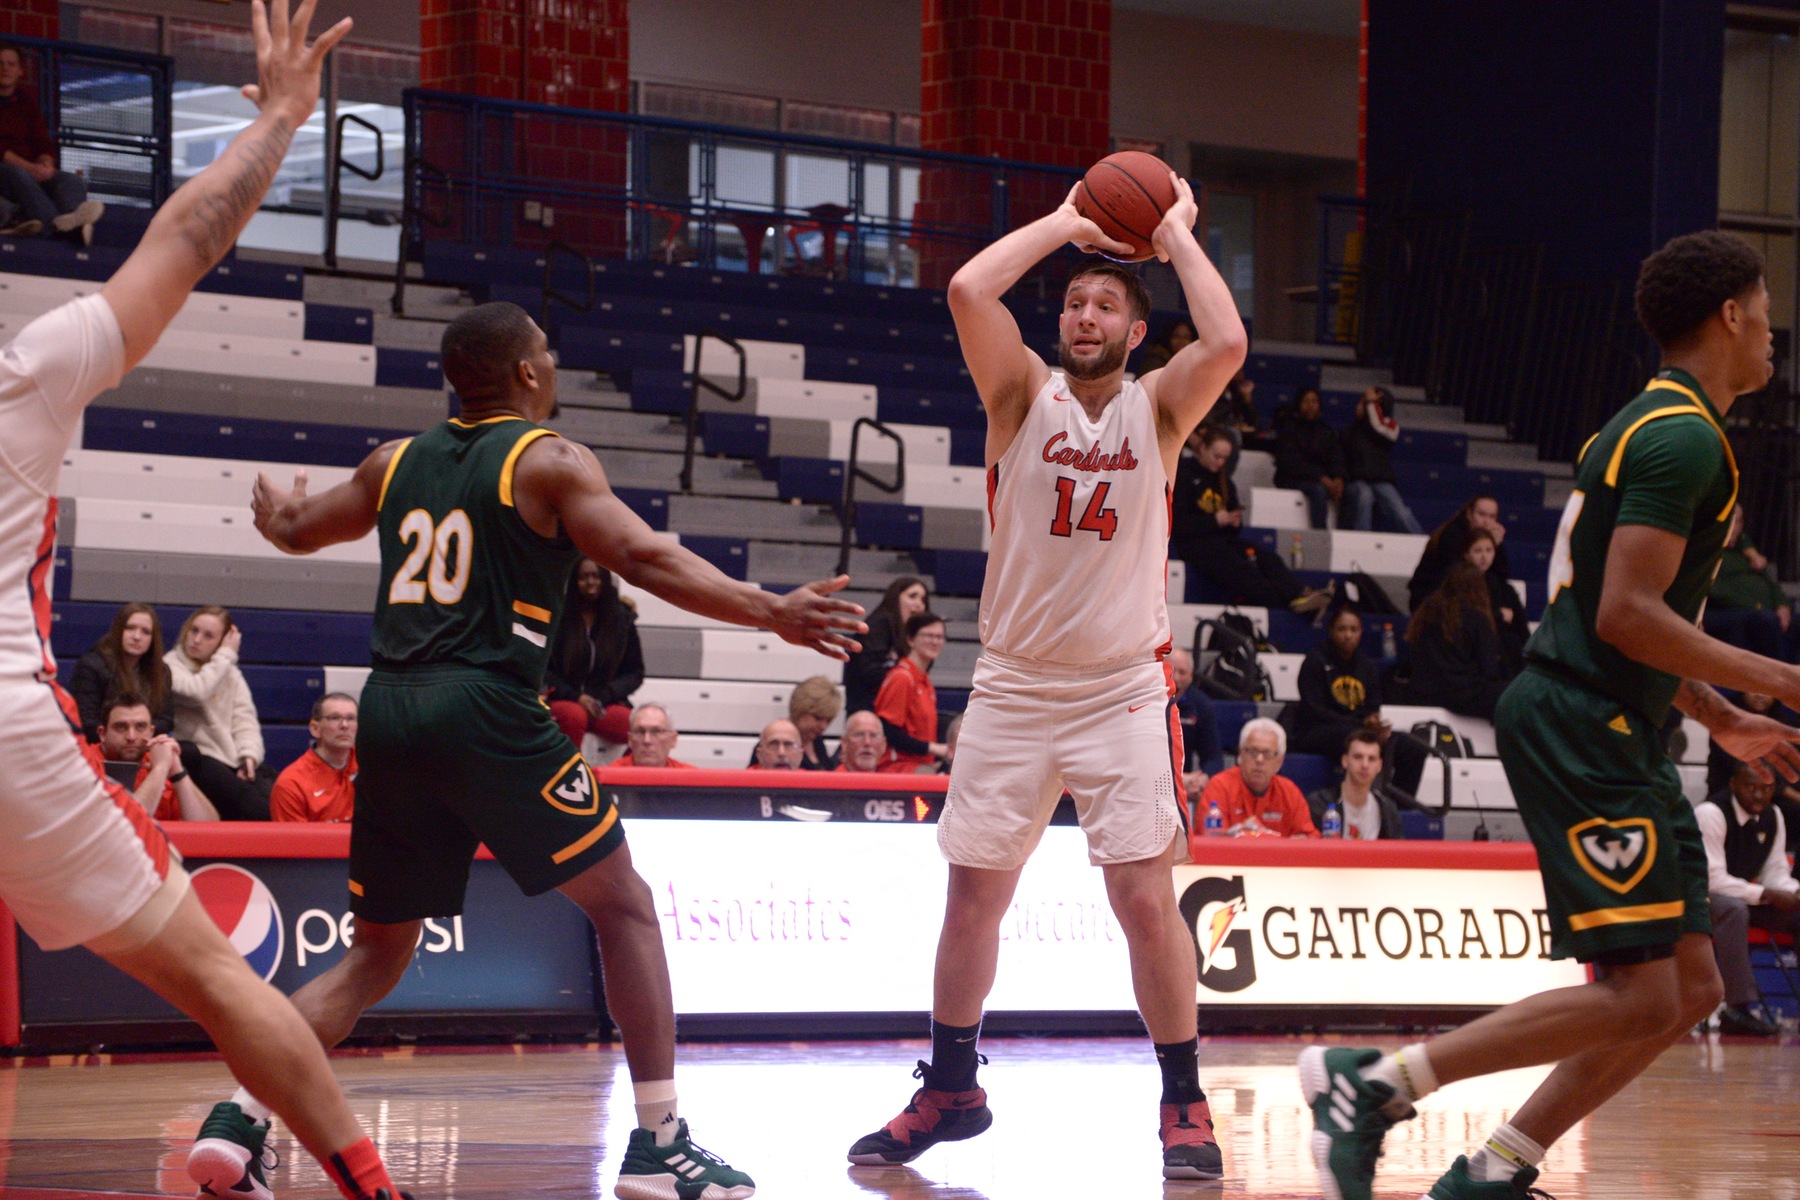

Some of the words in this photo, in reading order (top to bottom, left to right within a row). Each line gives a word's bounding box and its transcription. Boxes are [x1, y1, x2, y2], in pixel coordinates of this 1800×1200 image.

[1042, 430, 1138, 473] Cardinals
[1050, 475, 1118, 541] 14
[388, 508, 473, 605] 20
[296, 908, 464, 967] psi
[662, 880, 853, 942] Associates
[1179, 875, 1257, 993] G
[1262, 905, 1552, 961] GATORADE
